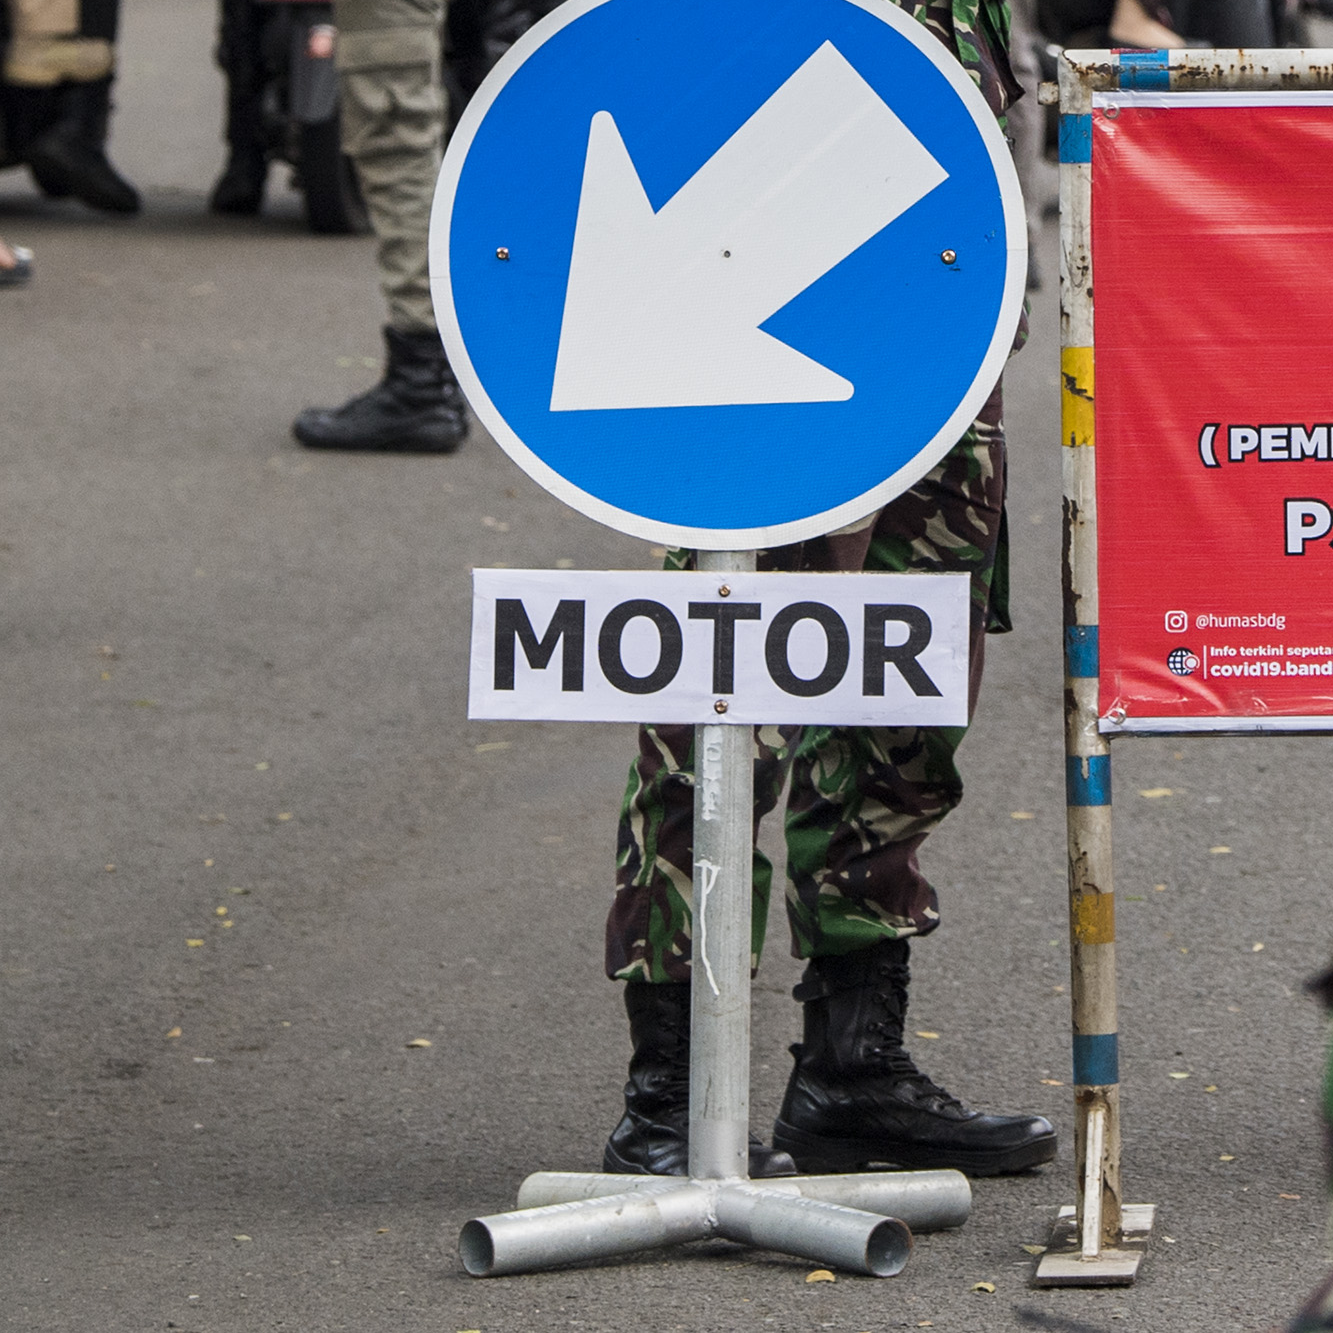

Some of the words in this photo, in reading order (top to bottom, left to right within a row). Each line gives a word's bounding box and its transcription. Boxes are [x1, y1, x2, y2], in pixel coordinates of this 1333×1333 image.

[1196, 612, 1286, 630] @humasbdg
[493, 598, 944, 698] MOTOR
[1210, 645, 1237, 657] Info
[1240, 644, 1284, 656] terkini
